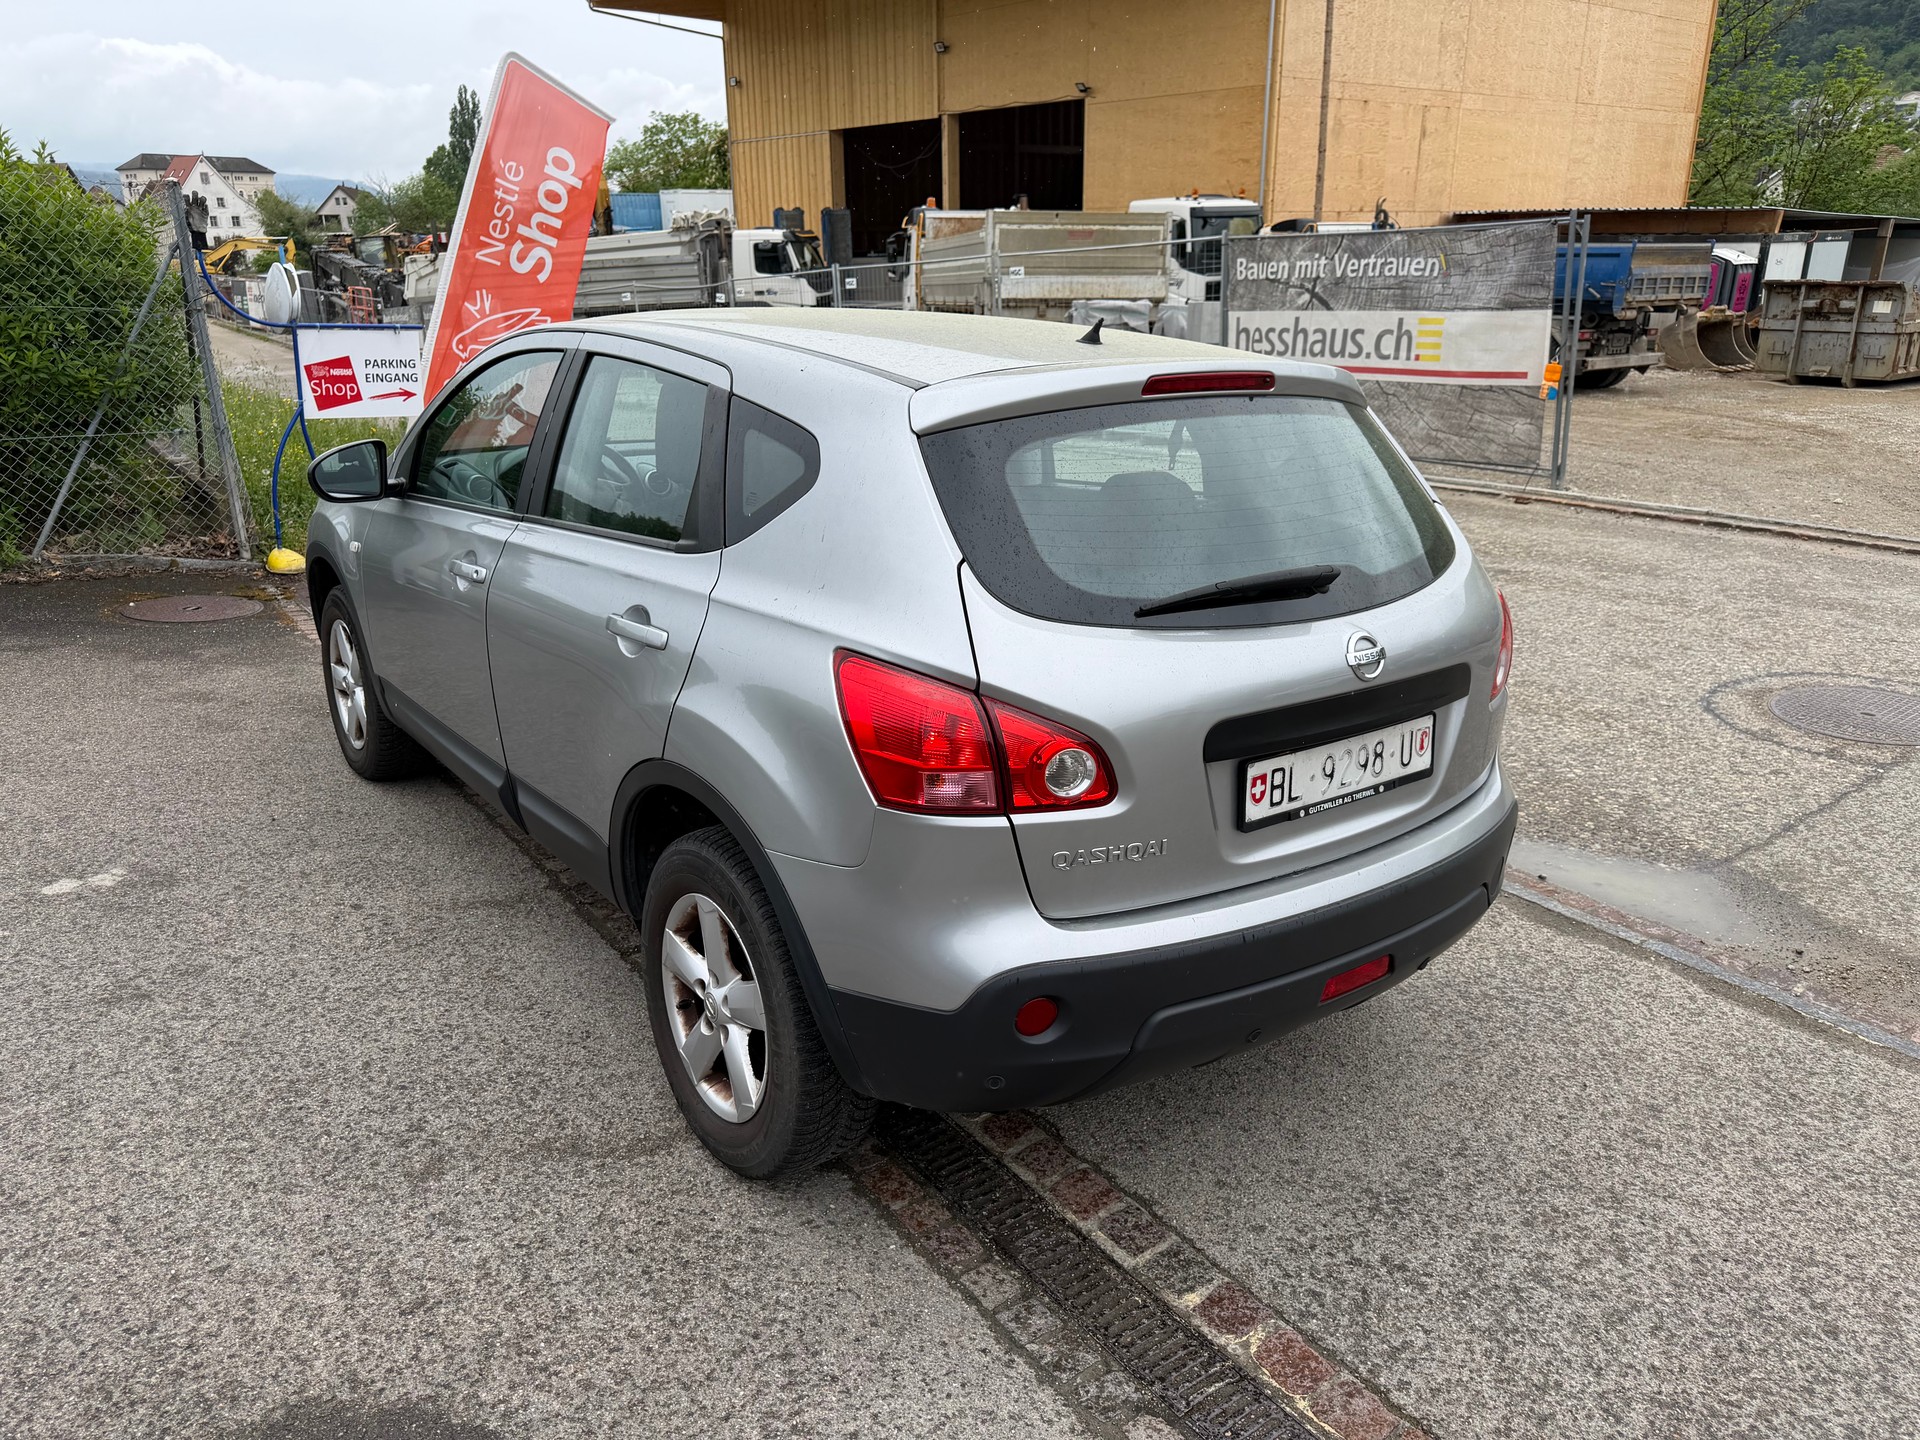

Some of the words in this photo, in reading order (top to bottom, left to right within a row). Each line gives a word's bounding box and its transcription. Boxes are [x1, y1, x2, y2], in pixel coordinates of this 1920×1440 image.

[475, 158, 524, 266] Nestlé
[509, 146, 583, 284] Shop
[1236, 258, 1289, 280] Bauen
[1294, 254, 1327, 279] mit
[1235, 317, 1412, 361] hesshaus.ch
[364, 359, 416, 369] PARKING
[310, 379, 357, 400] Shop
[365, 373, 419, 383] EINGANG
[1353, 648, 1385, 663] NISSAN
[1269, 766, 1302, 808] BL
[1320, 739, 1385, 796] 9298
[1400, 729, 1414, 769] U
[1308, 798, 1343, 814] GUTZWILLER
[1343, 795, 1352, 804] AG
[1352, 788, 1376, 801] THERWIL
[1051, 838, 1168, 870] QASHQAI
